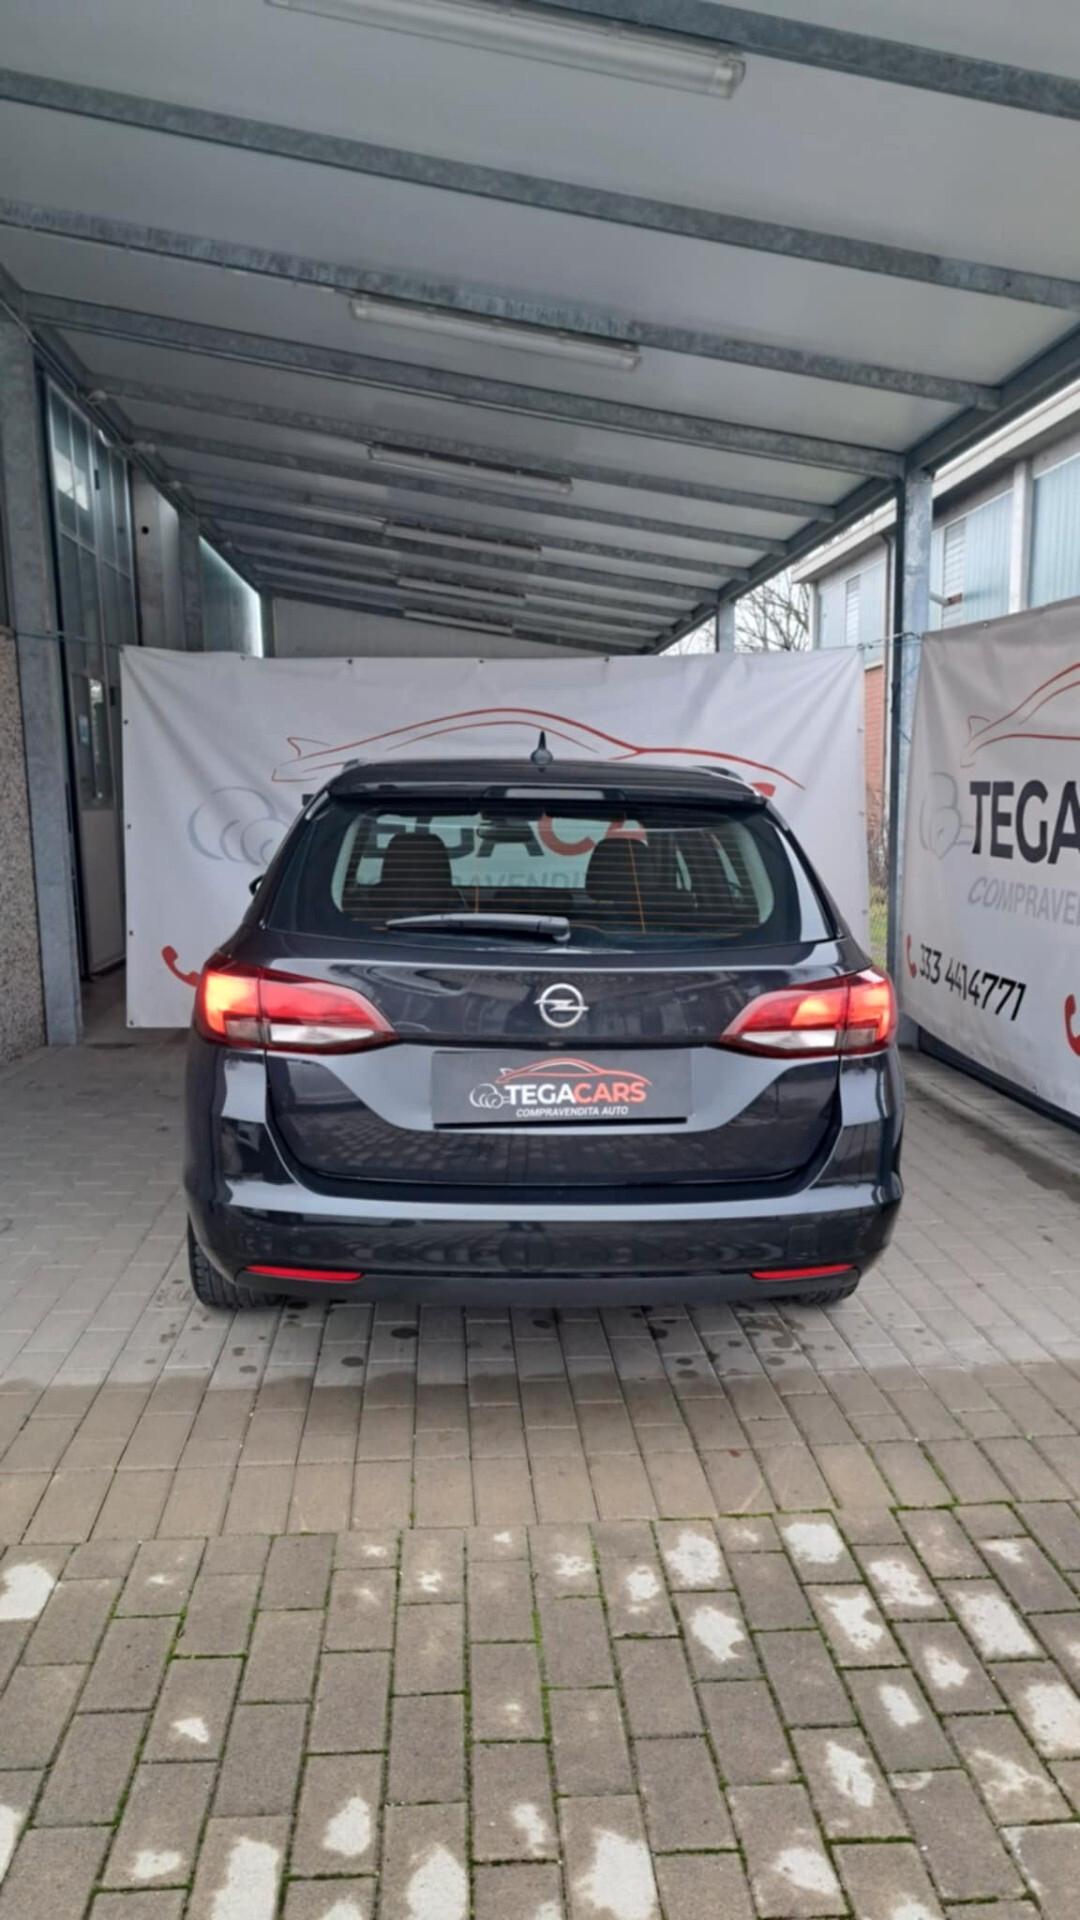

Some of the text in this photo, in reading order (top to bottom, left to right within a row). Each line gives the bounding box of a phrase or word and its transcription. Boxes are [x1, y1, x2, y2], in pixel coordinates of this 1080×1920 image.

[504, 1082, 647, 1105] TEGACARS
[516, 1105, 629, 1118] COMPRAVENDITA AUTO
